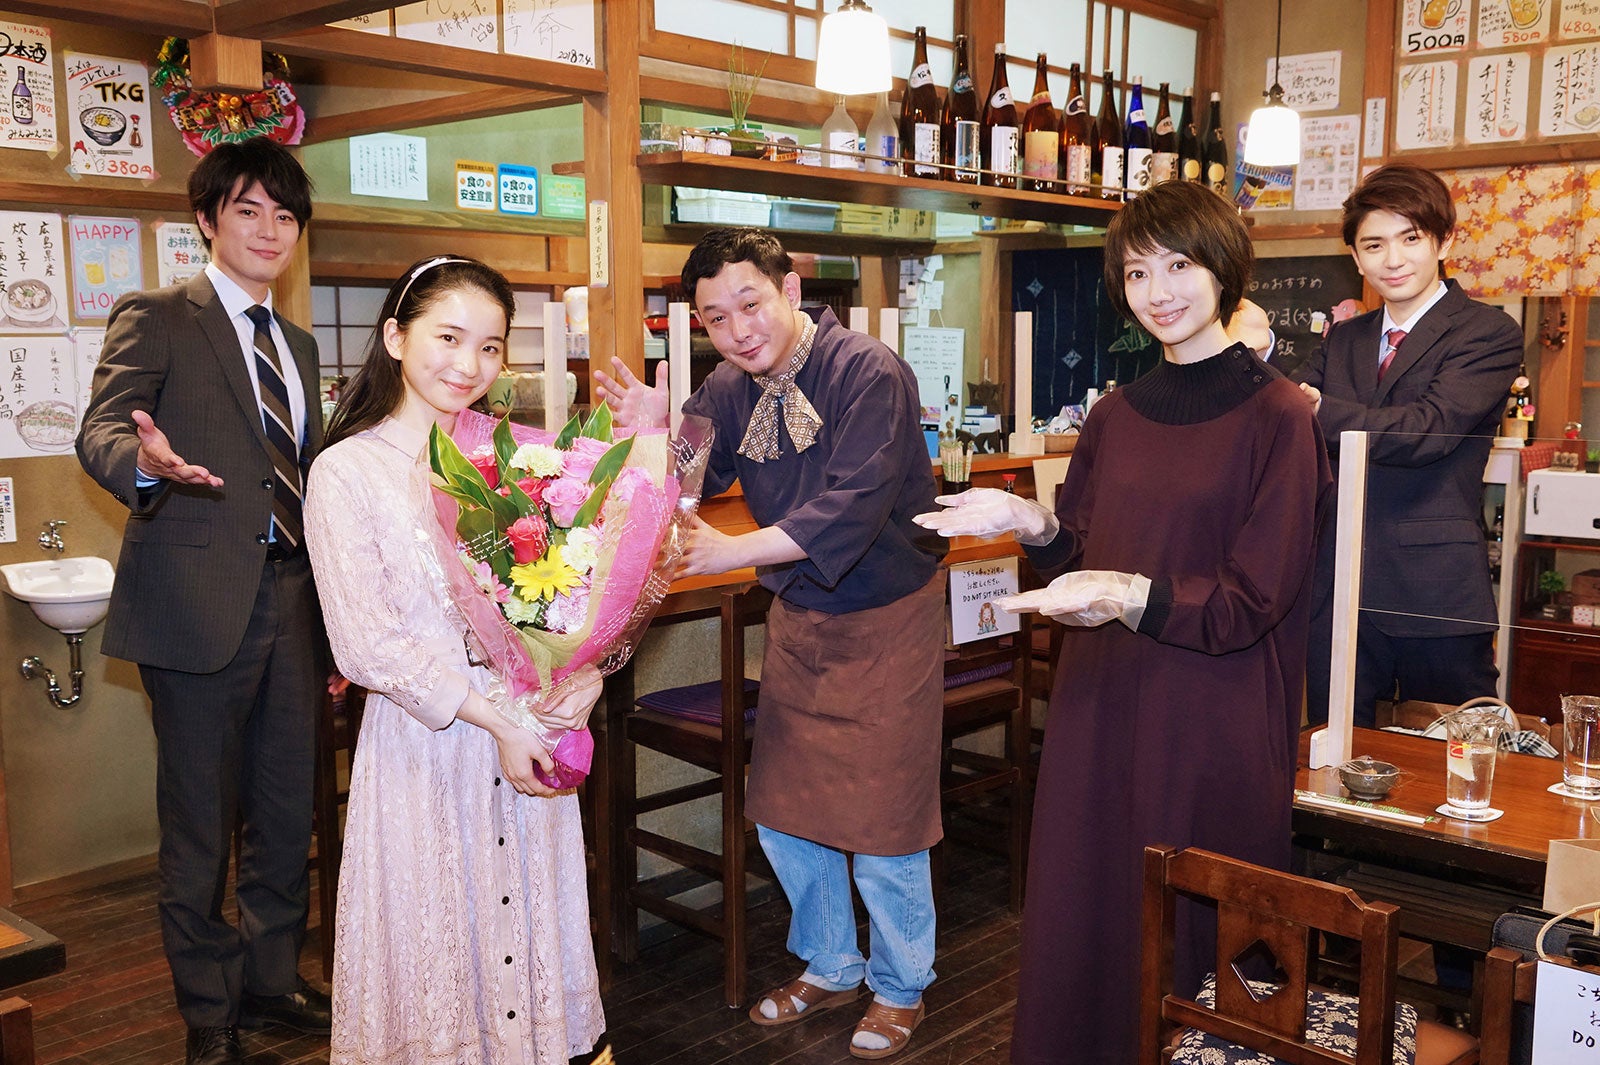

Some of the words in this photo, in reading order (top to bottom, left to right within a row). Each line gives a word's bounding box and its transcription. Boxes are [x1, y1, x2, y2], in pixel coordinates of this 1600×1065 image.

[1408, 32, 1465, 52] 500円
[94, 82, 144, 103] TKG
[107, 160, 152, 175] 380円
[467, 176, 485, 188] 食の
[510, 179, 527, 191] 食の
[460, 189, 493, 203] 安全宣言
[503, 192, 534, 206] 安全宣言
[74, 223, 135, 241] HAPPY
[1276, 338, 1297, 356] 飯
[971, 592, 982, 601] NOT
[983, 591, 992, 600] SIT
[992, 588, 1008, 598] HERE
[1573, 1030, 1595, 1048] DO
